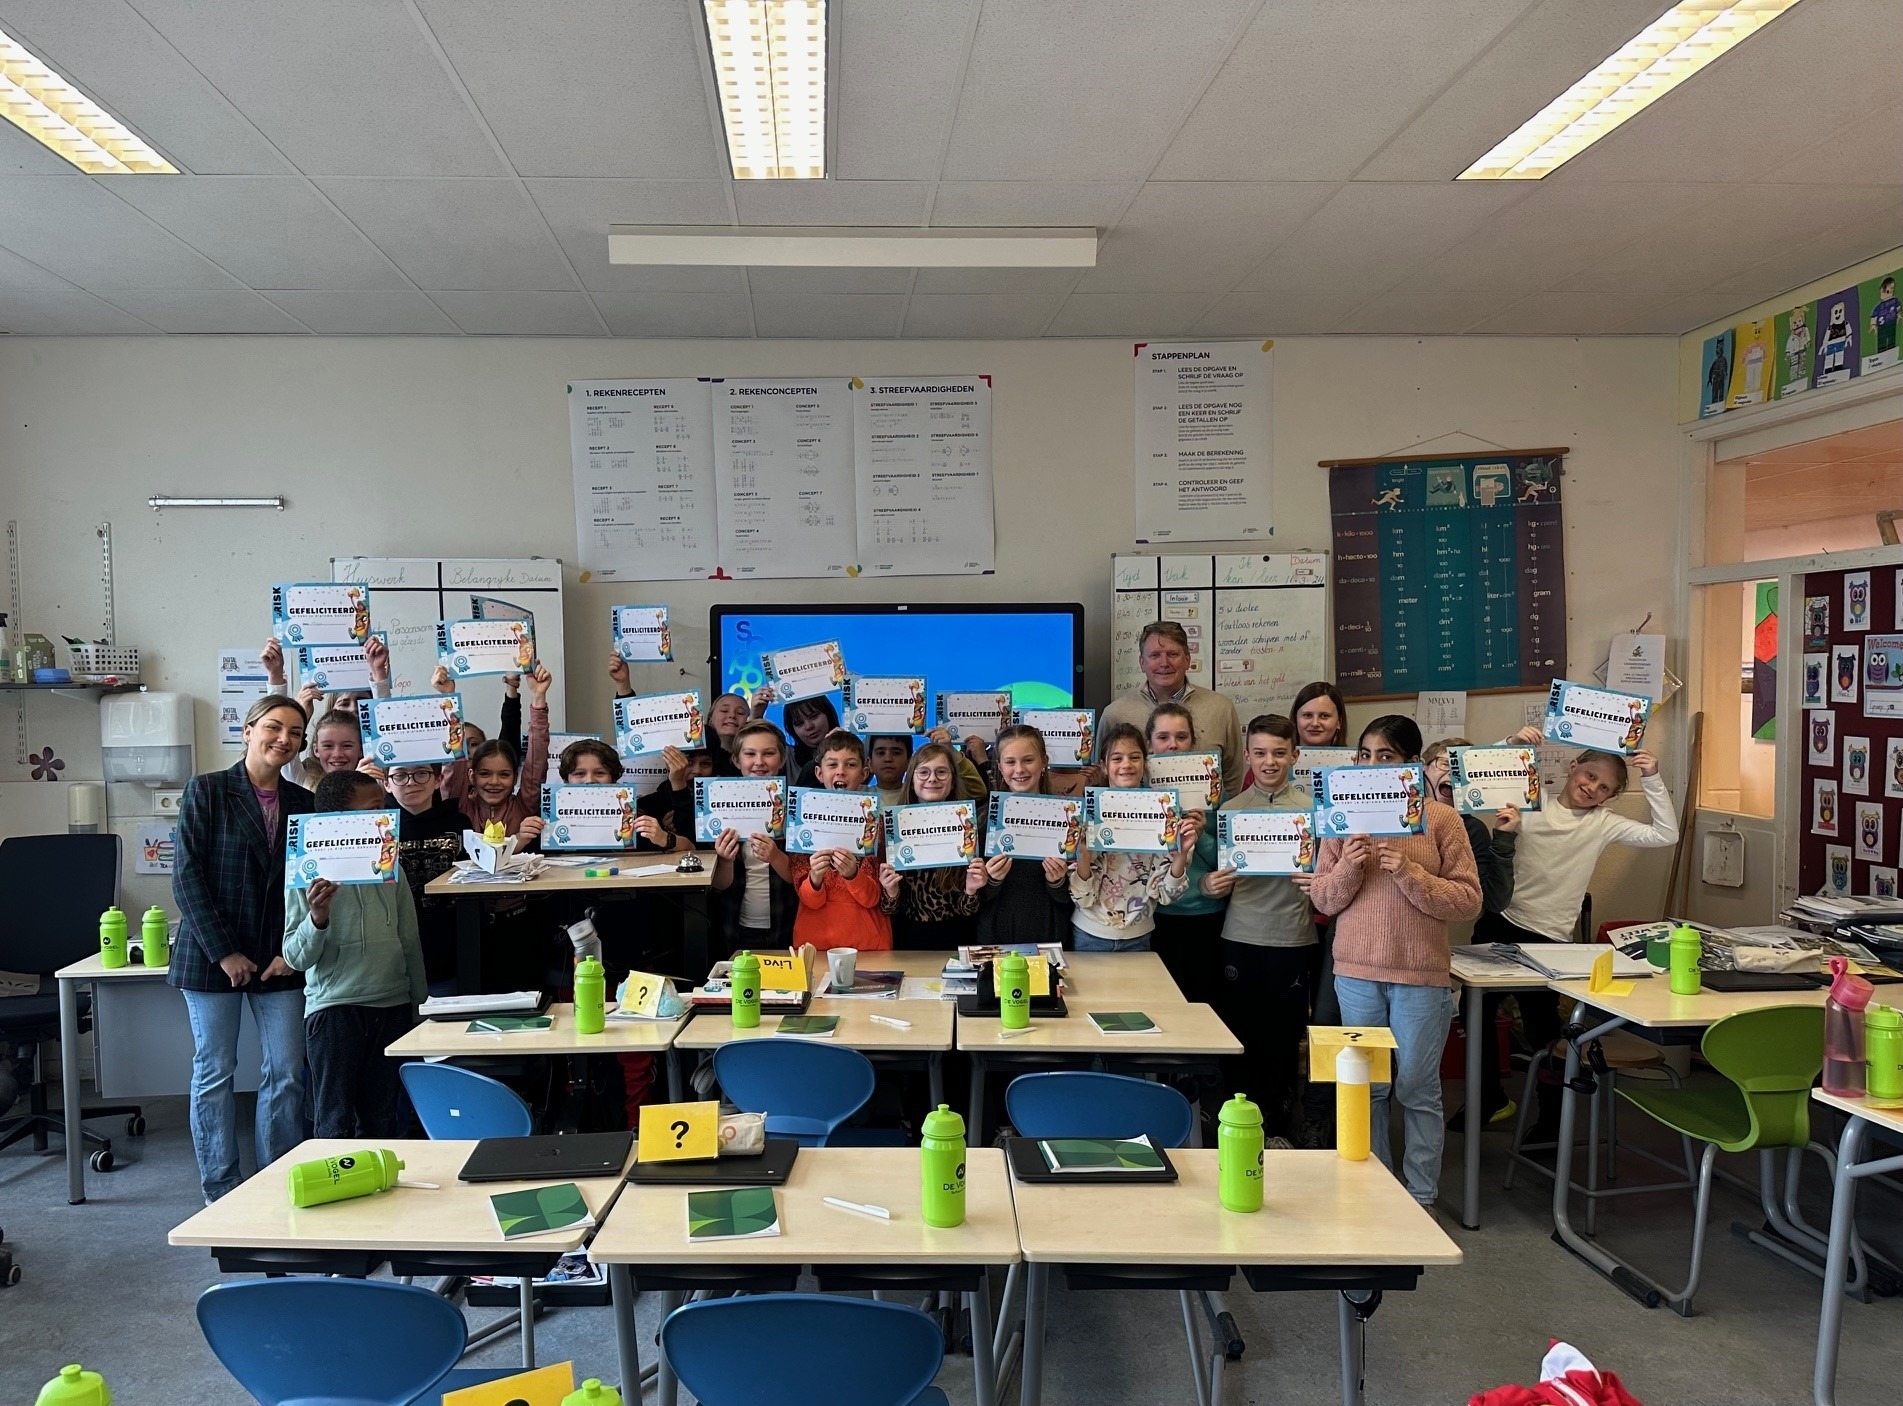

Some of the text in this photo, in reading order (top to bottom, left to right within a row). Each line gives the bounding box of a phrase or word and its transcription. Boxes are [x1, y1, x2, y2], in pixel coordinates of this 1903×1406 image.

[879, 386, 974, 394] STREEFVAARDIGHEDEN
[272, 586, 281, 614] RISK
[436, 624, 447, 647] RISK
[1300, 630, 1310, 640] of
[762, 655, 771, 676] RISK
[778, 659, 833, 676] GEFELICITEERD
[1550, 683, 1562, 708] RISK
[360, 703, 371, 731] RISK
[614, 702, 623, 726] RISK
[630, 712, 689, 726] GEFELICITEERD
[1564, 705, 1631, 724] GEFELICITEERD
[379, 720, 448, 732] GEFELICITEERD
[1450, 750, 1459, 778] RISK
[1150, 774, 1210, 784] GEFELICITEERD
[1468, 770, 1527, 779] GEFELICITEERD
[694, 781, 704, 806] RISK
[1313, 771, 1324, 799] RISK
[542, 787, 551, 814] RISK
[711, 800, 772, 809] GEFELICITEERD
[789, 790, 797, 817] RISK
[1086, 790, 1094, 817] RISK
[1332, 792, 1407, 801] GEFELICITEERD
[558, 808, 622, 817] GEFELICITEERD
[990, 794, 1000, 822] RISK
[1102, 811, 1165, 820] GEFELICITEERD
[802, 813, 865, 824] GEFELICITEERD
[885, 810, 894, 835] RISK
[1004, 817, 1068, 828] GEFELICITEERD
[1219, 813, 1227, 839] RISK
[288, 819, 299, 848] RISK
[901, 825, 963, 836] GEFELICITEERD
[1234, 834, 1300, 842] GEFELICITEERD
[306, 838, 381, 848] GEFELICITEERD
[764, 959, 792, 969] Liva
[638, 985, 648, 1006] ?
[1343, 1032, 1362, 1042] ?
[670, 1120, 690, 1149] ?
